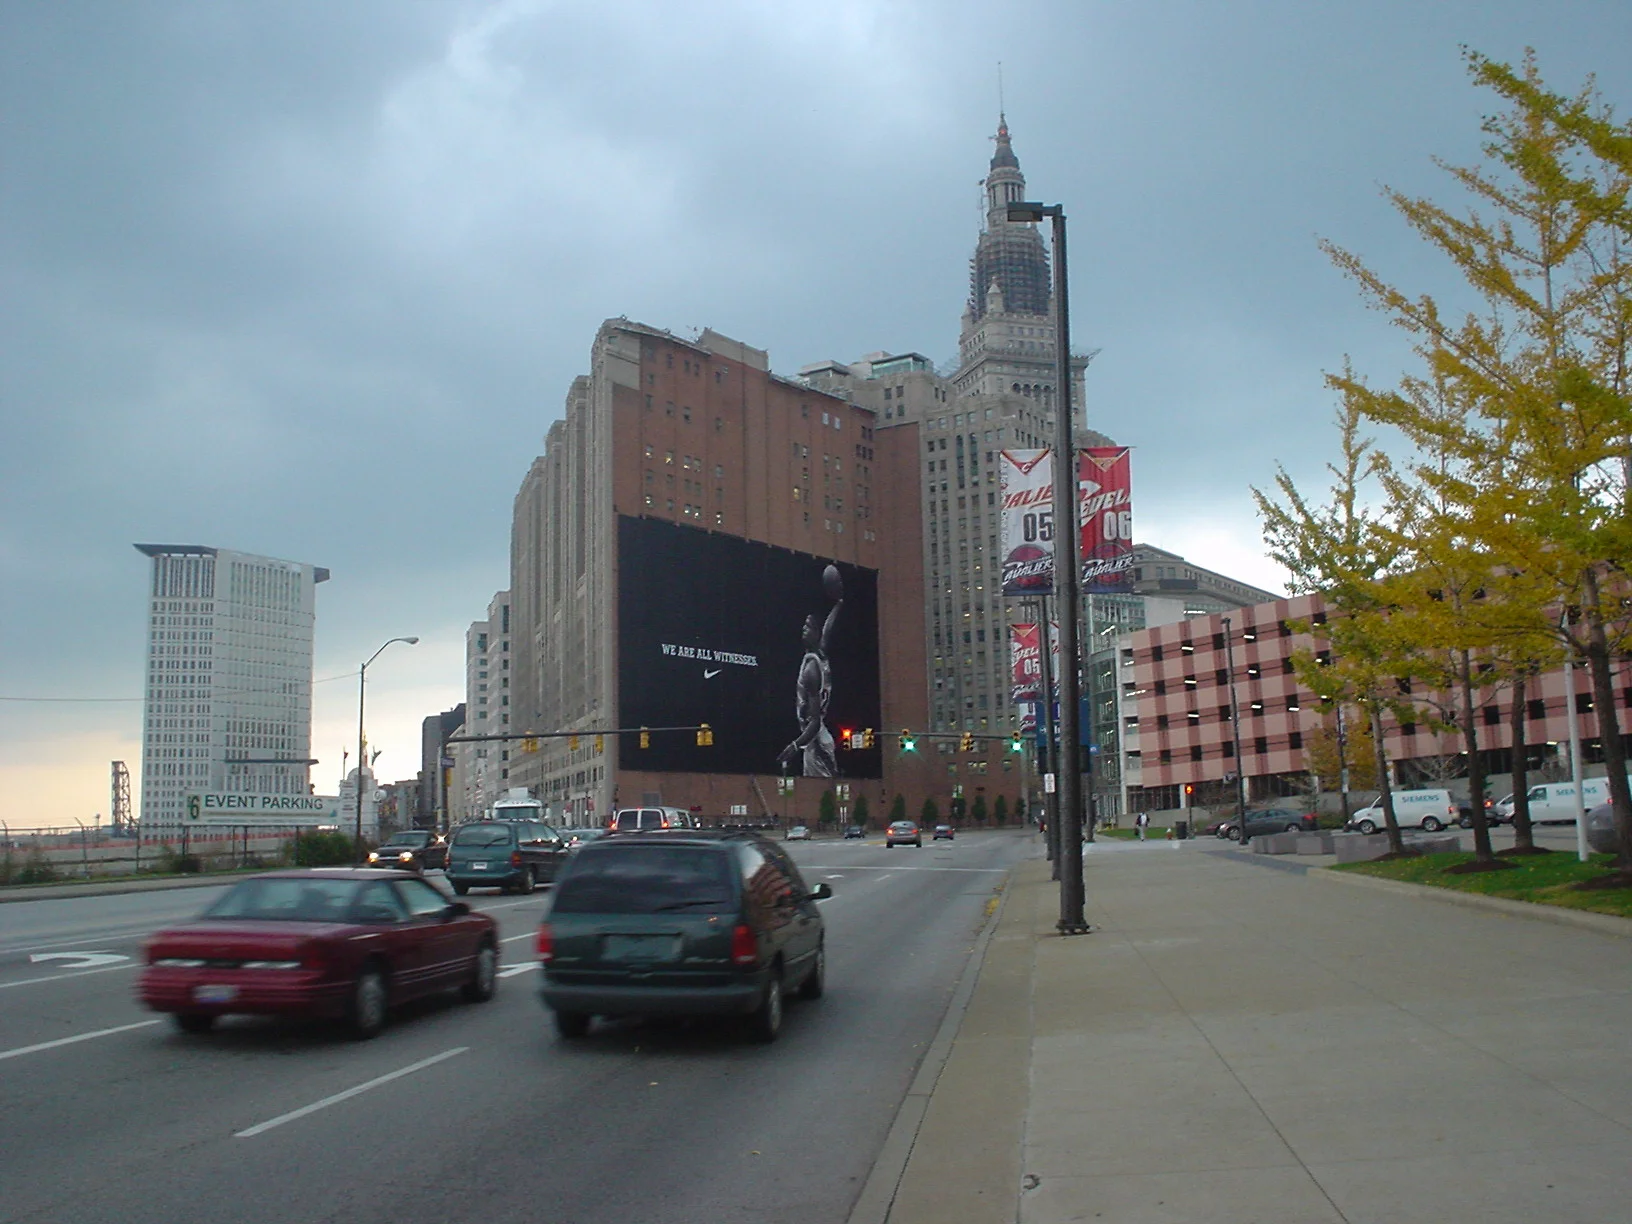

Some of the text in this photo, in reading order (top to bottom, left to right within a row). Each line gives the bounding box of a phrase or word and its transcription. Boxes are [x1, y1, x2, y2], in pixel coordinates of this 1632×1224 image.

[1023, 511, 1054, 542] 05
[1103, 510, 1132, 541] 06
[661, 643, 677, 656] WE
[677, 645, 695, 659] ARE
[696, 648, 713, 661] ALL
[1401, 795, 1440, 803] SIEMENS
[1555, 786, 1598, 797] SIEMNS
[204, 794, 257, 808] EVENT
[261, 796, 324, 810] PARKING
